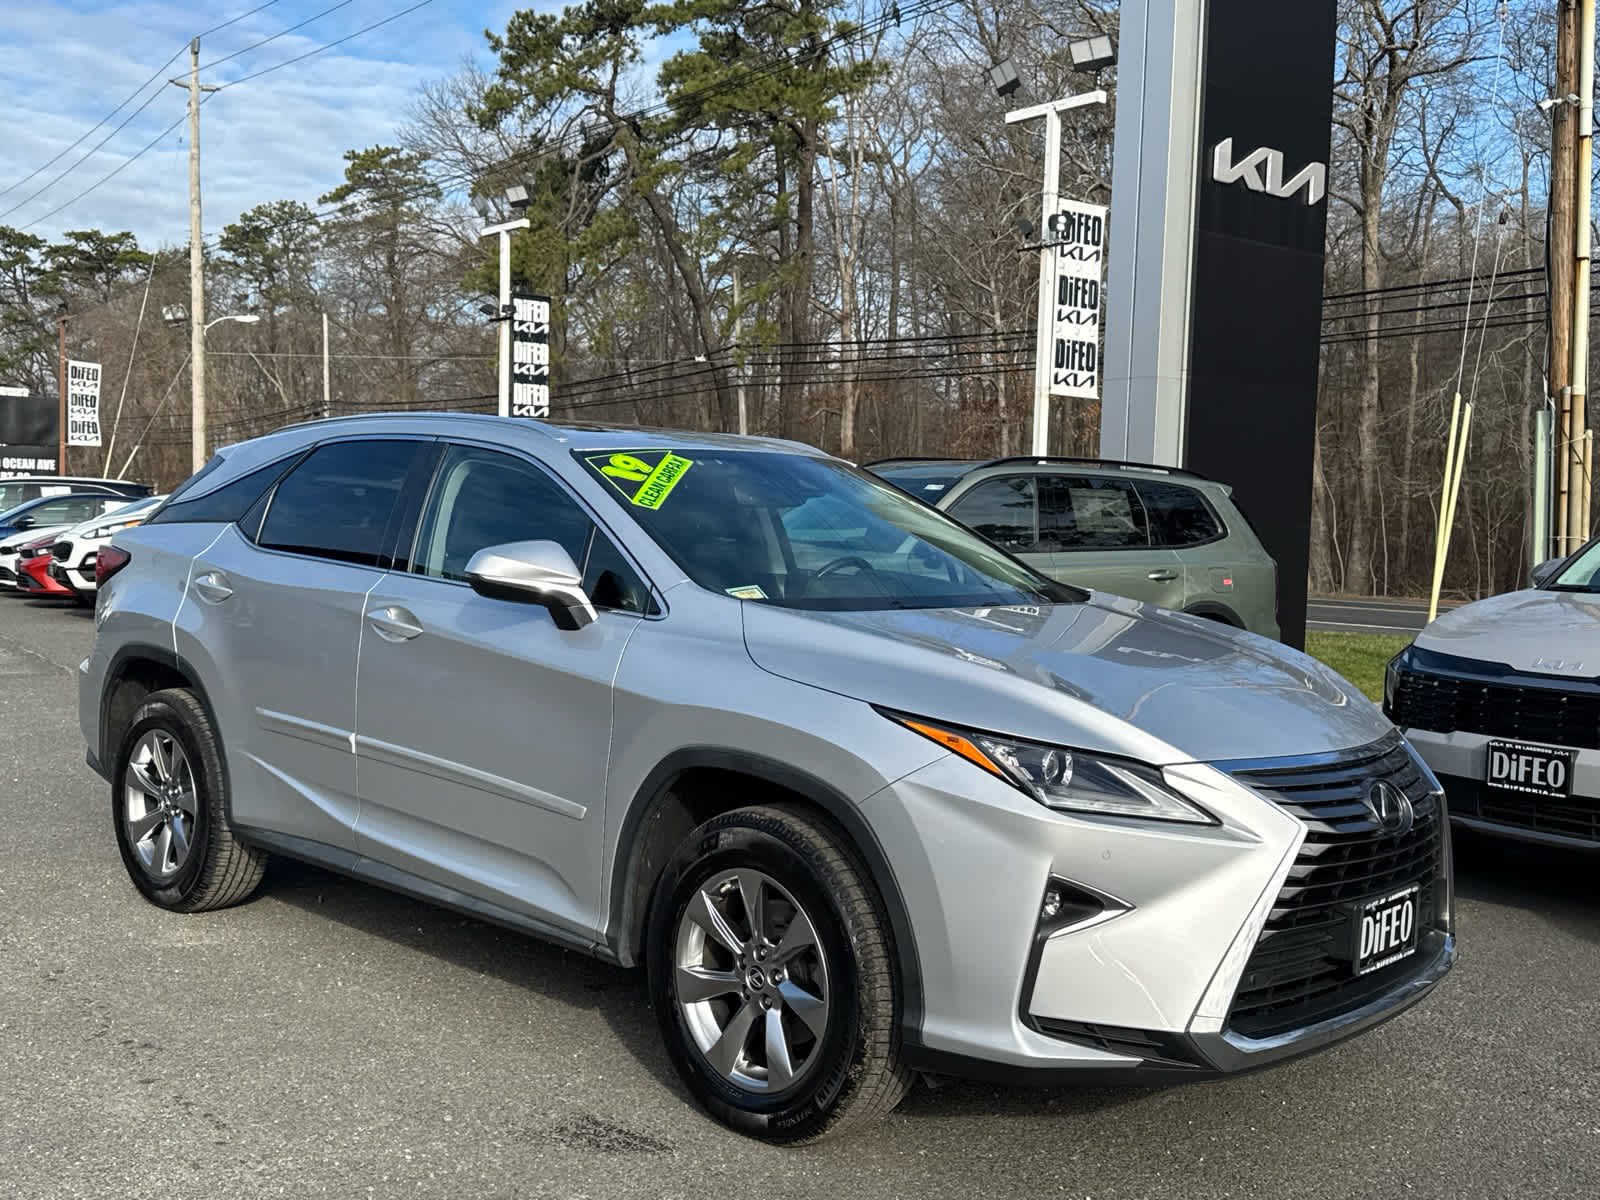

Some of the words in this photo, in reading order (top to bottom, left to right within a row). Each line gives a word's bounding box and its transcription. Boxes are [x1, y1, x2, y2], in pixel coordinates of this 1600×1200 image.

[1213, 137, 1326, 206] KIA
[1058, 275, 1099, 310] DiFEO
[1055, 338, 1096, 373] DiFEO
[2, 457, 35, 470] OCEAN
[36, 459, 56, 471] AVE
[600, 454, 654, 481] 19
[638, 481, 666, 506] CLEAN
[656, 457, 682, 483] CARFAX
[1492, 751, 1565, 788] DiFEO
[1360, 900, 1413, 959] DiFEO
